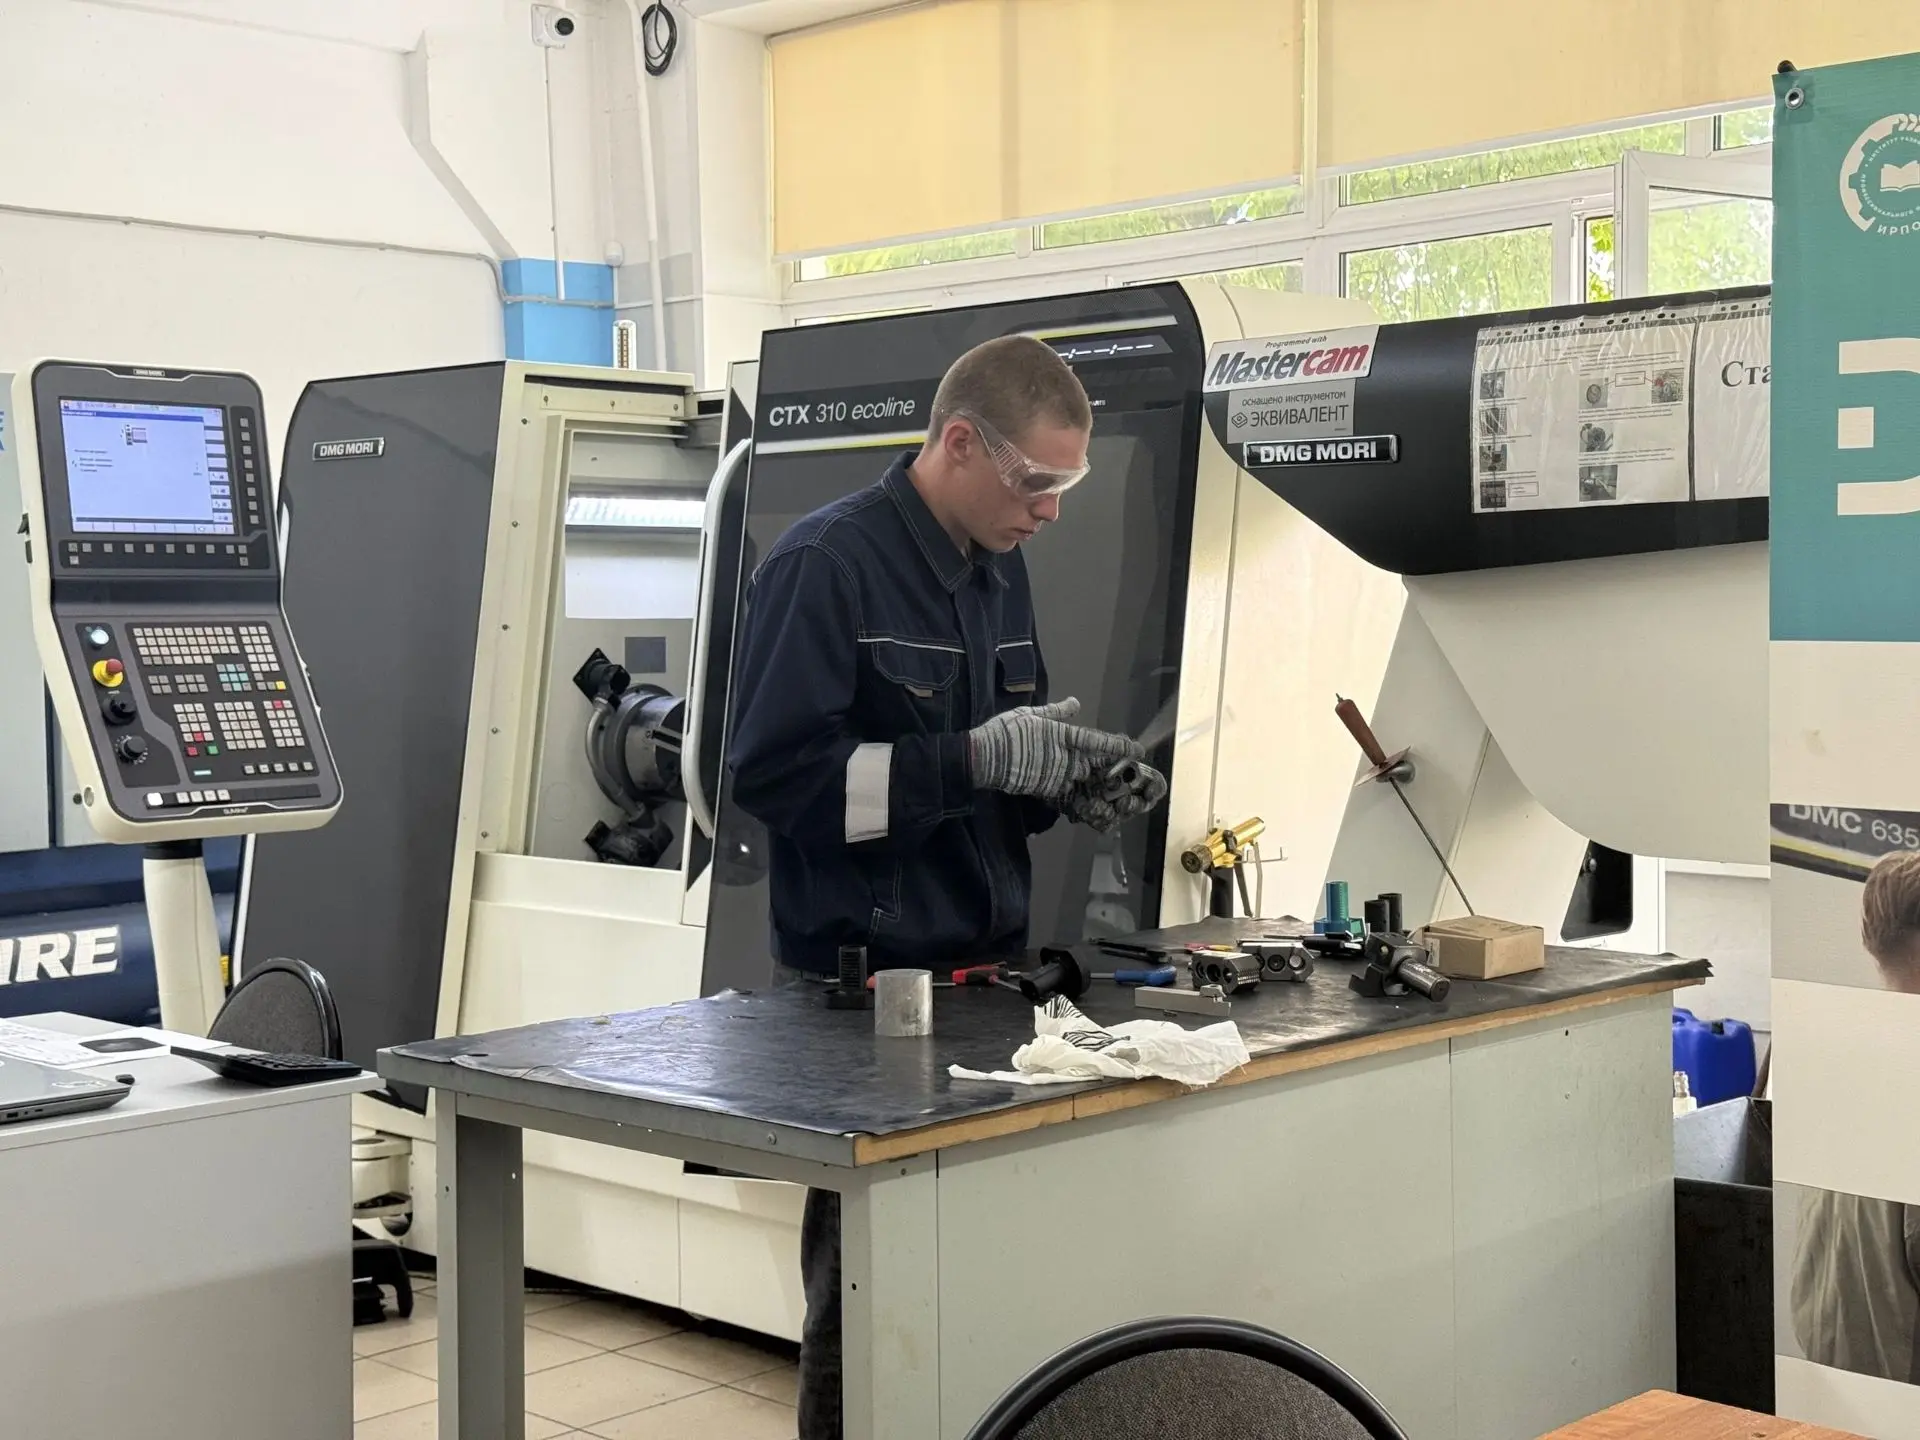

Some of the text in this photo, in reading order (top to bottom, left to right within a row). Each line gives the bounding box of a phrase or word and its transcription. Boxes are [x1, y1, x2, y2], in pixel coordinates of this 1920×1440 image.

[1264, 335, 1328, 349] Programmed with
[1207, 344, 1370, 387] Mastercam
[1242, 391, 1346, 407] оснащено инструментом
[769, 396, 916, 427] CTX 310 ecoline
[1250, 404, 1349, 428] ЭКВИВАЛЕНТ
[320, 441, 374, 457] DMG MORI
[1260, 441, 1377, 463] DMG MORI
